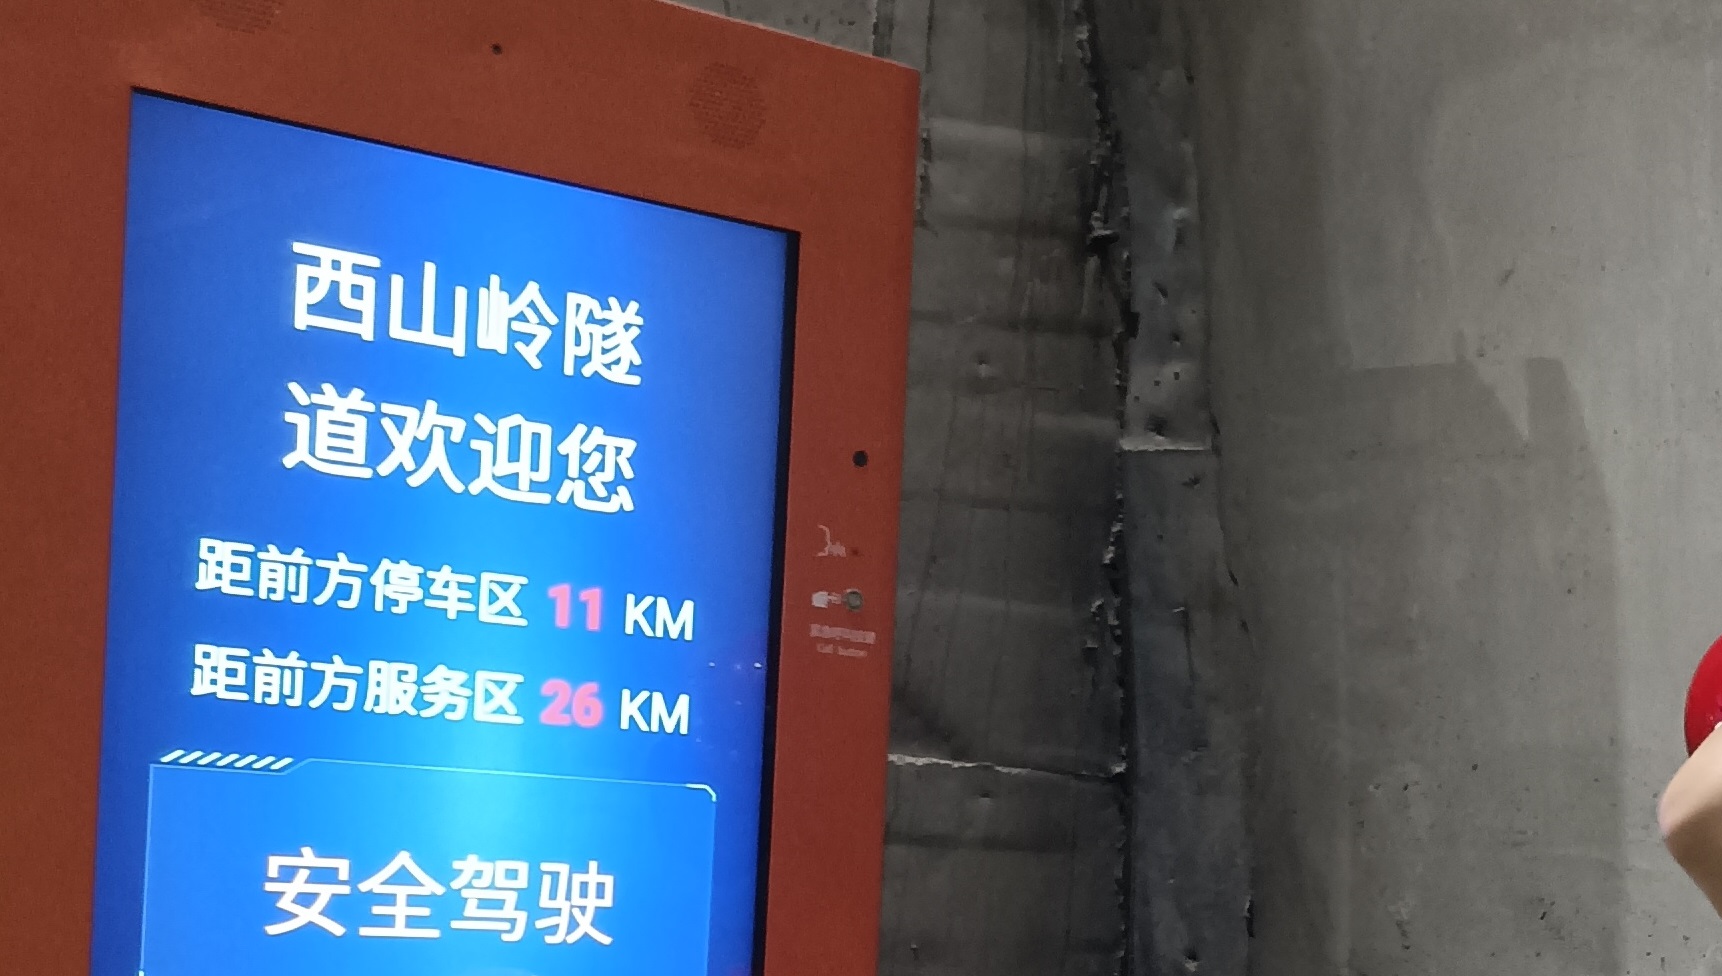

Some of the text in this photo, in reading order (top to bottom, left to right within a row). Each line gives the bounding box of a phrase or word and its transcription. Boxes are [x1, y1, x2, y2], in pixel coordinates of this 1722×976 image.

[291, 240, 645, 387] 西山岭隧
[282, 381, 638, 515] 道欢迎您
[194, 537, 696, 642] 距前方停车区 11 KM
[190, 643, 692, 736] 距前方服务区 26 KM
[262, 847, 616, 947] 安全驾驶
